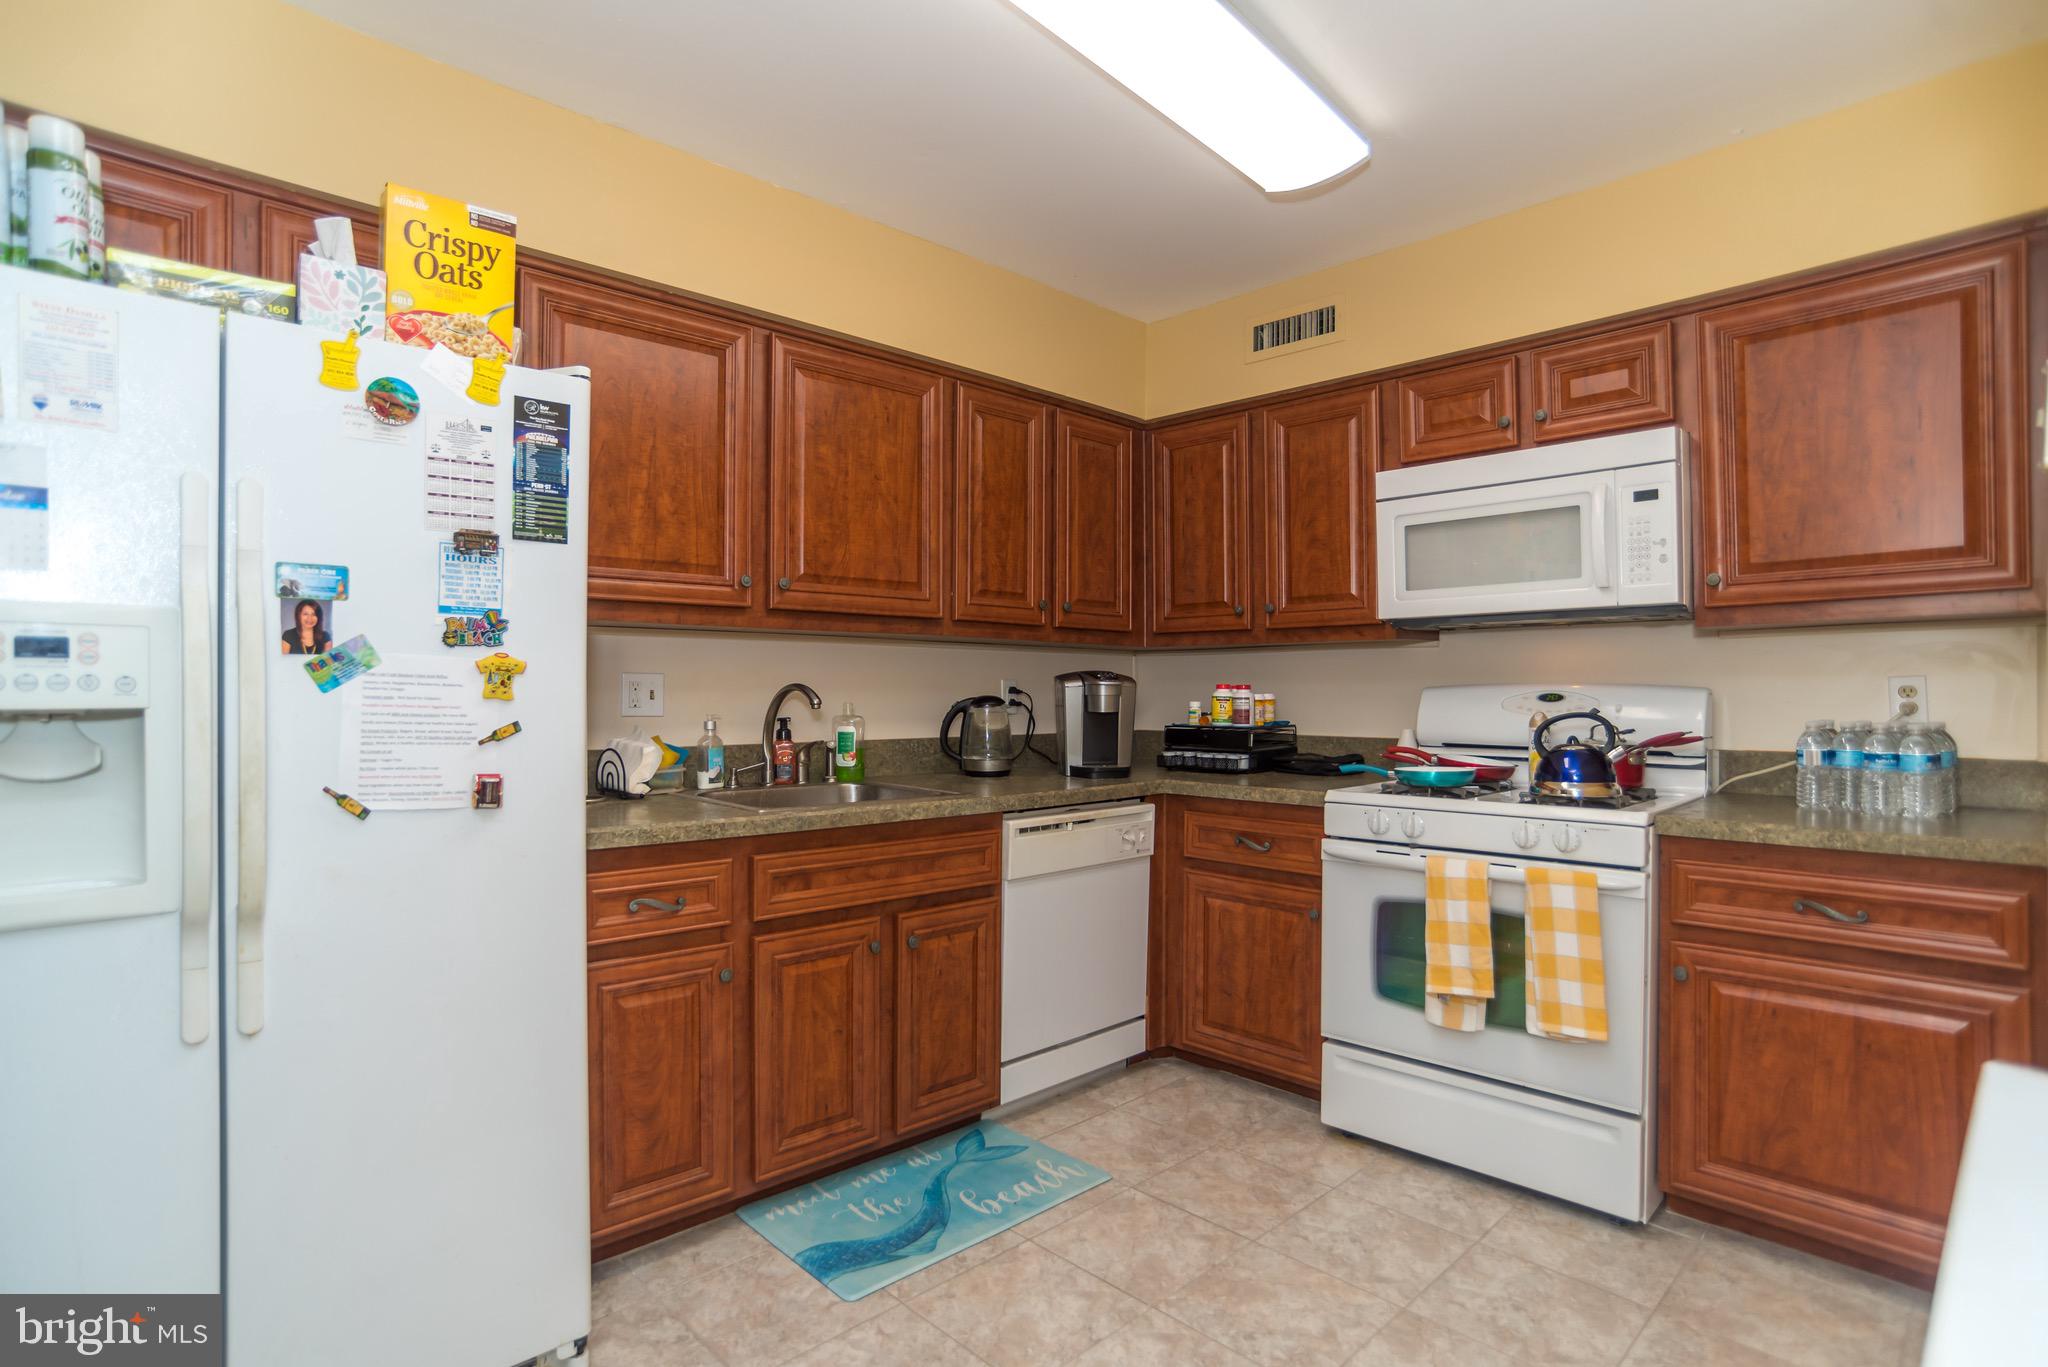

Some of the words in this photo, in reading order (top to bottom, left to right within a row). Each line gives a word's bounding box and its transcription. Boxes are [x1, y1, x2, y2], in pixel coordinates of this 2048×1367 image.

[403, 219, 501, 271] Crispy
[414, 251, 483, 290] Oats
[267, 304, 289, 316] 160
[445, 553, 497, 565] HOURS
[445, 617, 489, 632] PALM
[458, 630, 504, 646] BEACH
[765, 1182, 841, 1222] meet
[850, 1165, 897, 1188] me
[907, 1147, 942, 1168] at
[831, 1195, 912, 1223] the
[959, 1158, 1089, 1215] beach
